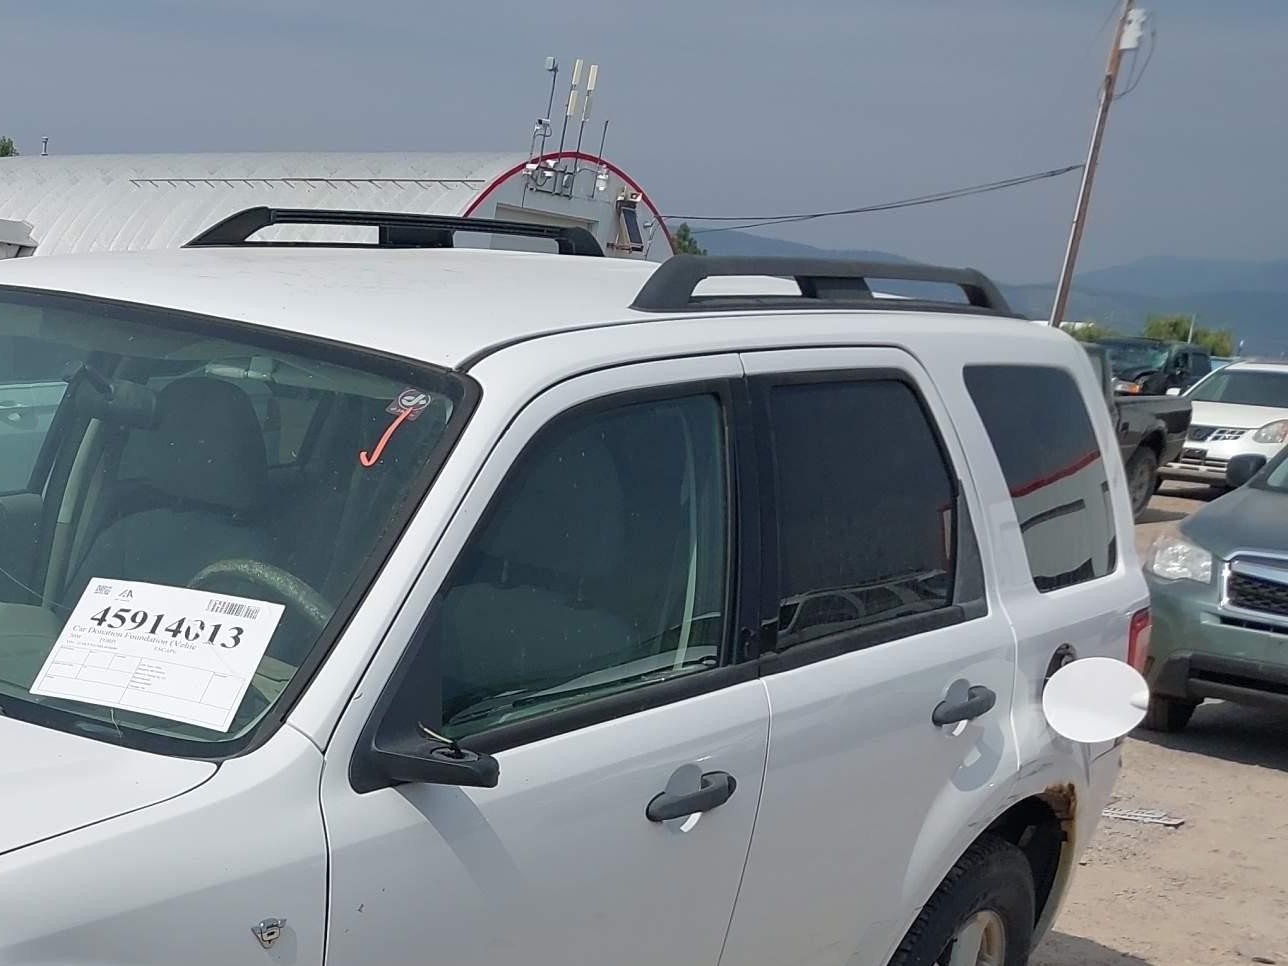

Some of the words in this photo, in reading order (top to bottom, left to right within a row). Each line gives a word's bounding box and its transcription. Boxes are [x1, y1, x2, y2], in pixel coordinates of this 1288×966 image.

[88, 626, 123, 638] Donation
[124, 632, 169, 645] Foundation
[90, 605, 245, 649] 45914013
